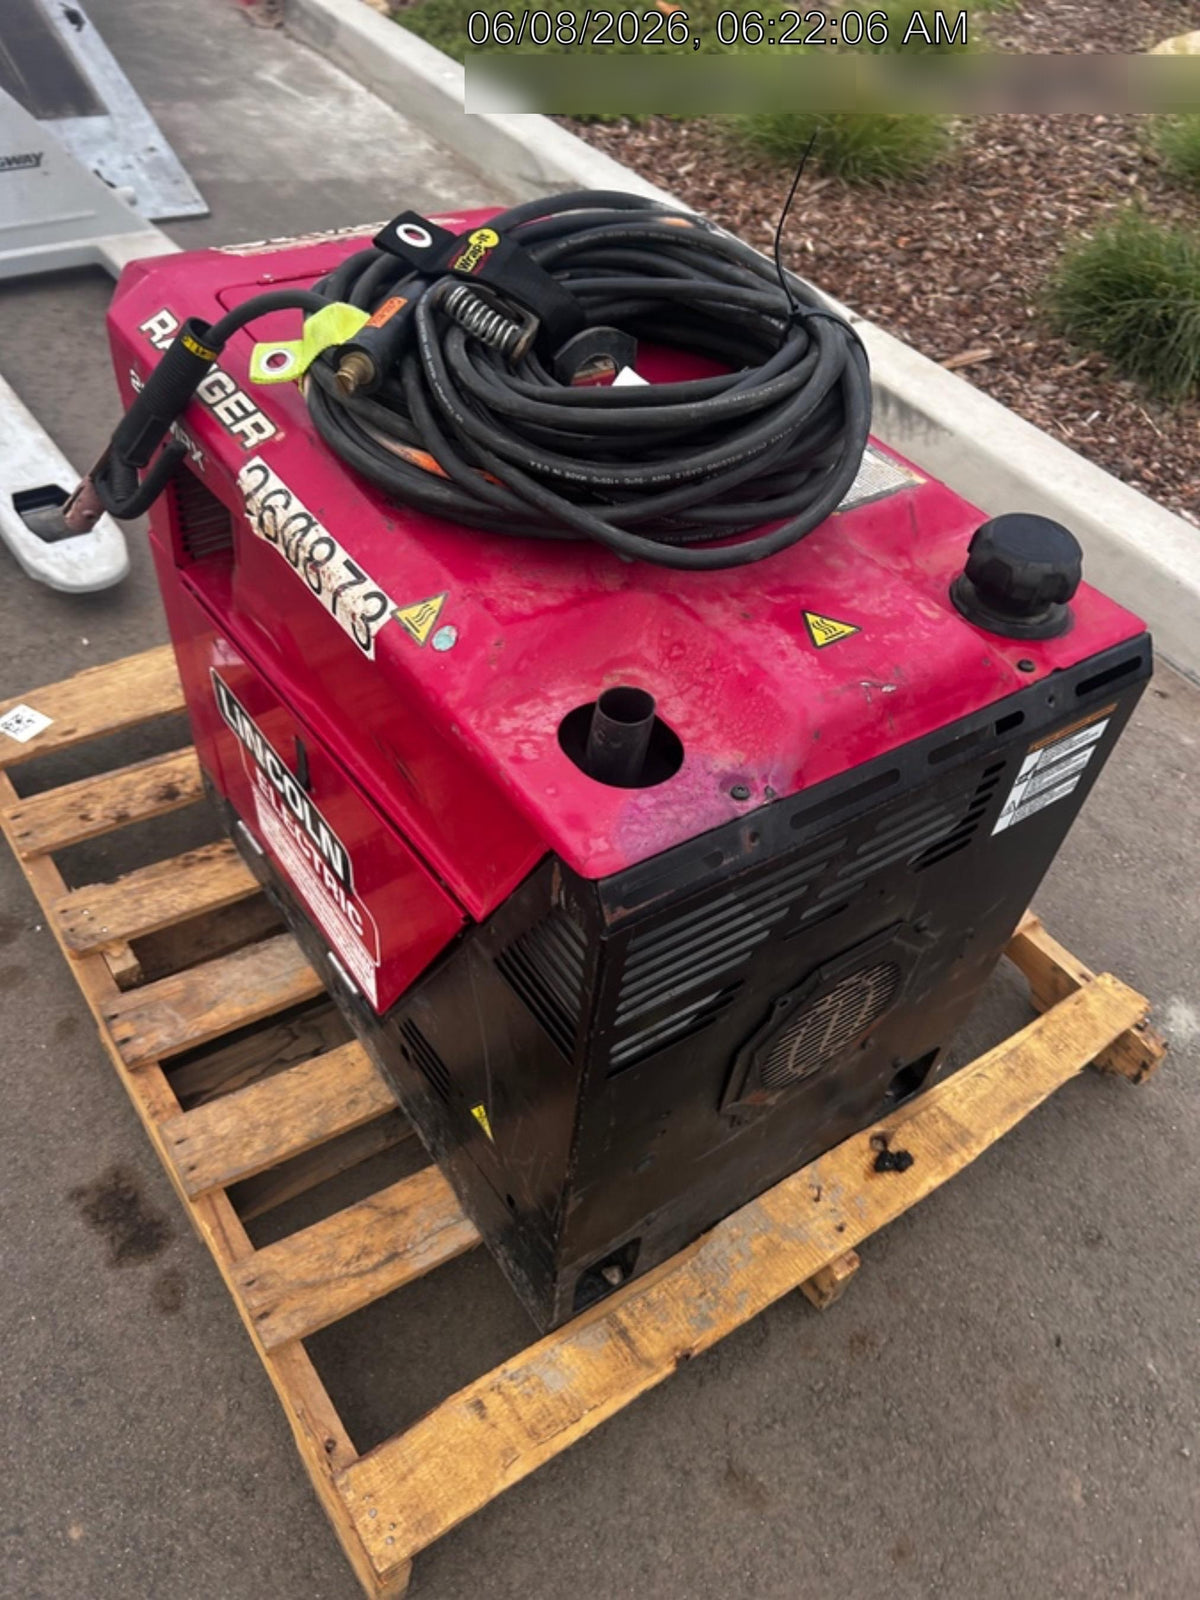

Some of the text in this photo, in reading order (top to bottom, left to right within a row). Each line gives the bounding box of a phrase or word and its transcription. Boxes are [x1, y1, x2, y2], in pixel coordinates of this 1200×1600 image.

[139, 308, 278, 450] RGER
[218, 684, 346, 882] LINCOLN
[254, 765, 364, 938] ELECTRIC
